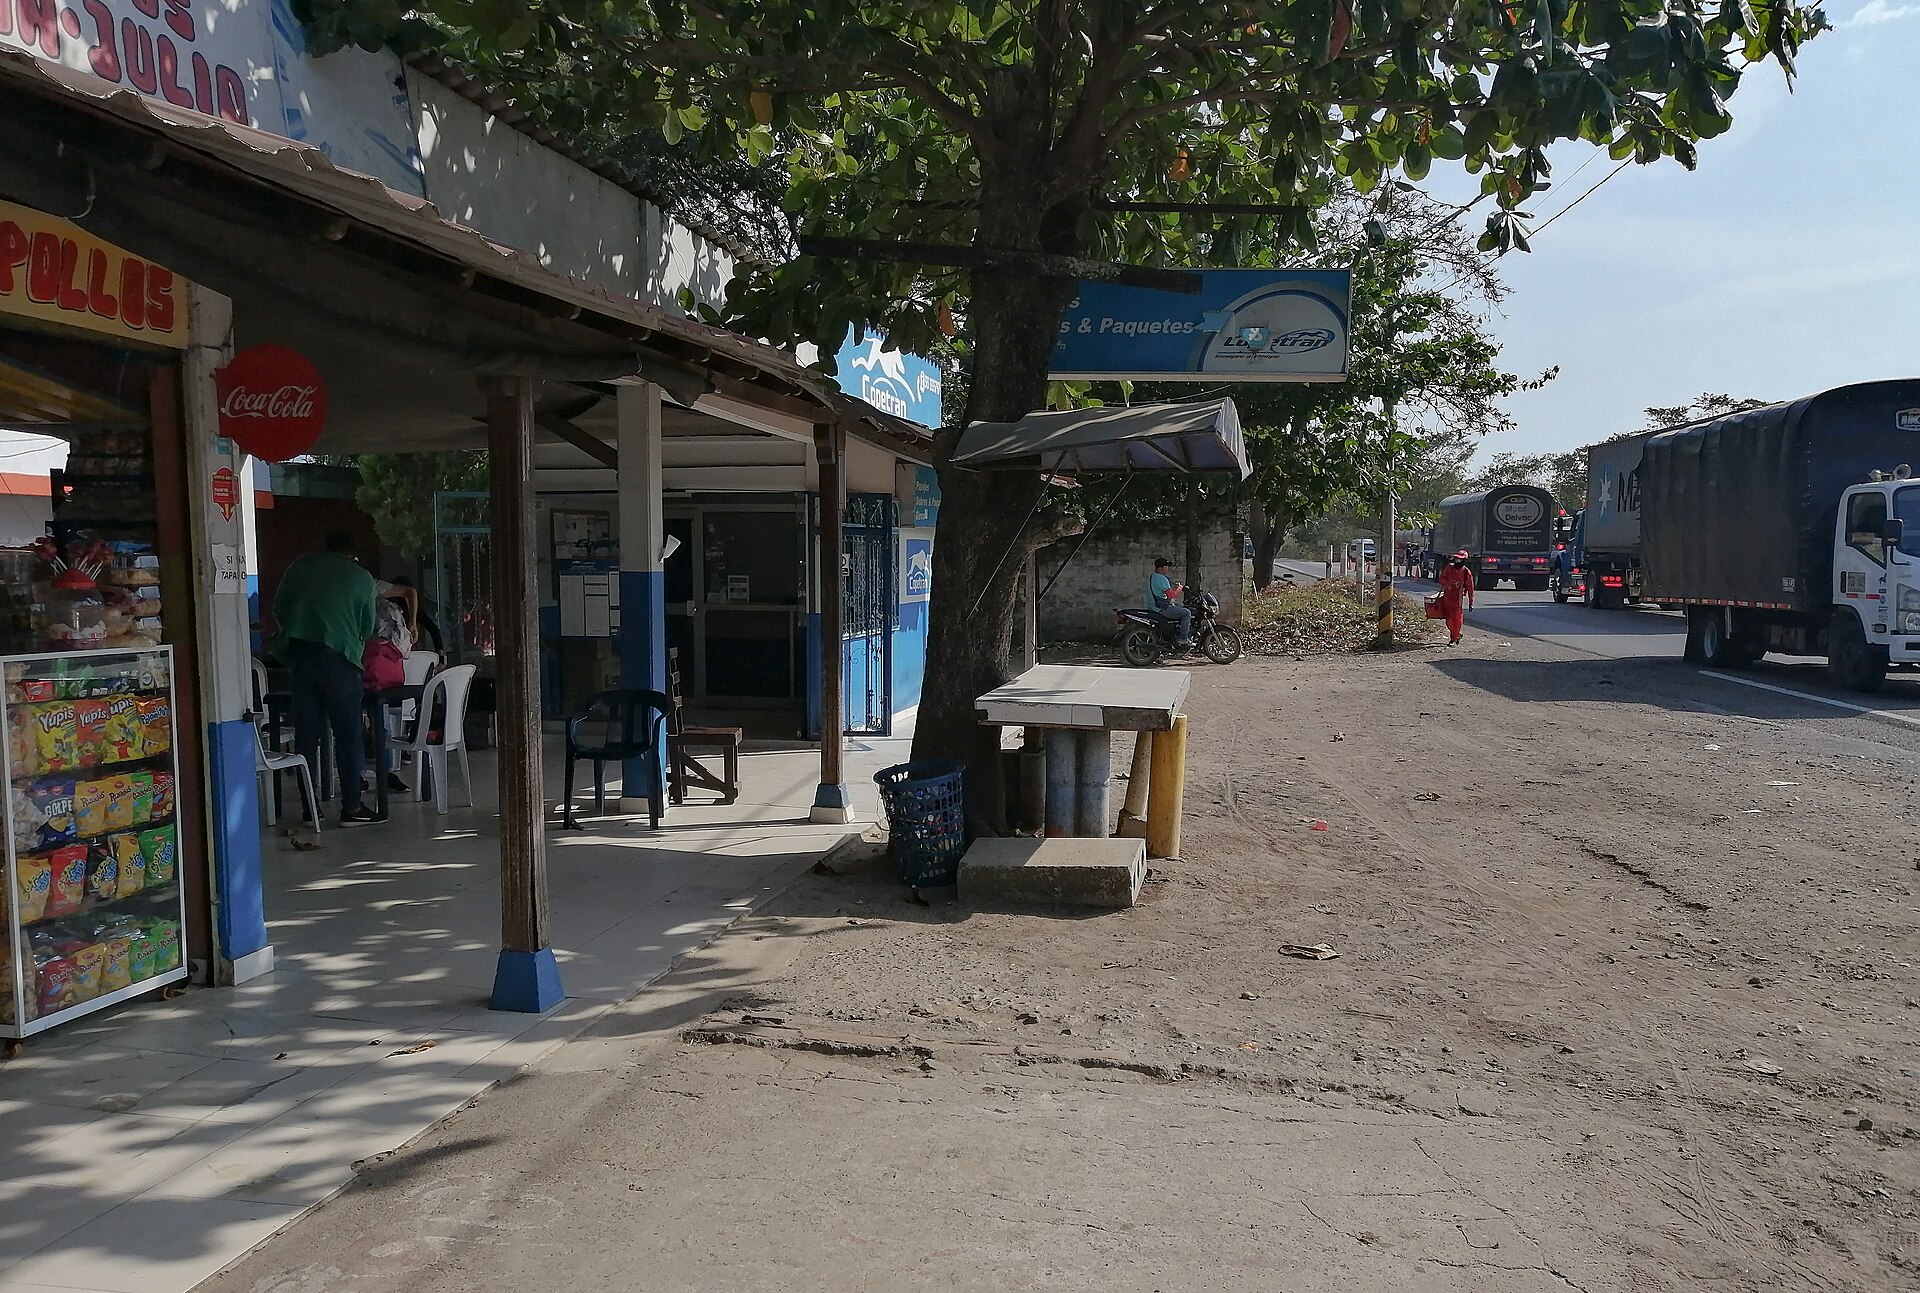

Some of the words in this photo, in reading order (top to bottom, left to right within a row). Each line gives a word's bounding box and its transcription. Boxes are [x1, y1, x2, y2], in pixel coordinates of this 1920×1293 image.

[1077, 317, 1093, 334] &
[1099, 316, 1194, 337] Paquetes
[220, 384, 319, 419] Coca-Cola
[861, 374, 907, 418] Copetran
[1504, 505, 1528, 513] Mobil
[1504, 514, 1532, 522] Delvac
[221, 571, 246, 580] TAPAO
[110, 698, 134, 715] upis
[39, 706, 75, 733] Yupis
[79, 708, 107, 728] Yupis
